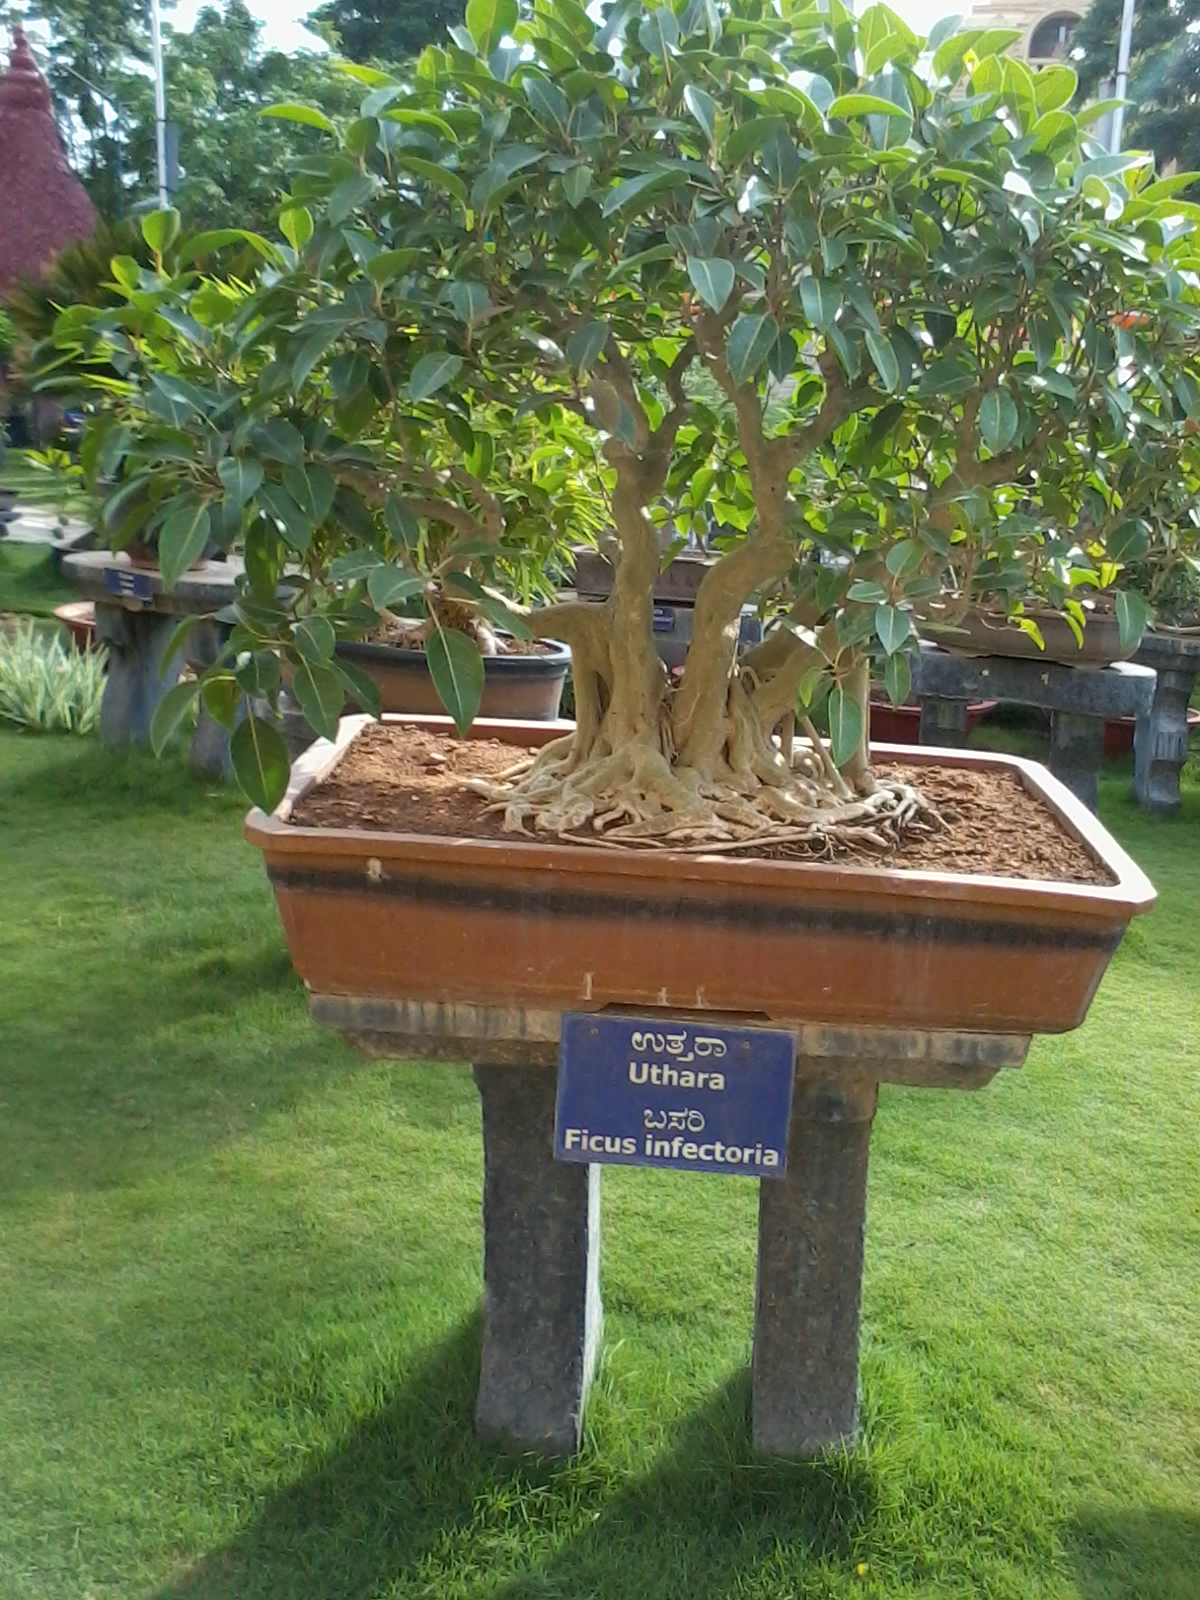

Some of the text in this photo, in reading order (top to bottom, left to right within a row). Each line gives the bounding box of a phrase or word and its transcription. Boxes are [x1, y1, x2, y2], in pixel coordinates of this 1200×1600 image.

[631, 1030, 728, 1062] ಉತ್ತರಾ
[628, 1061, 726, 1090] Uthara
[643, 1107, 706, 1132] ಬಸರಿ
[564, 1128, 779, 1166] Ficus infectoria
